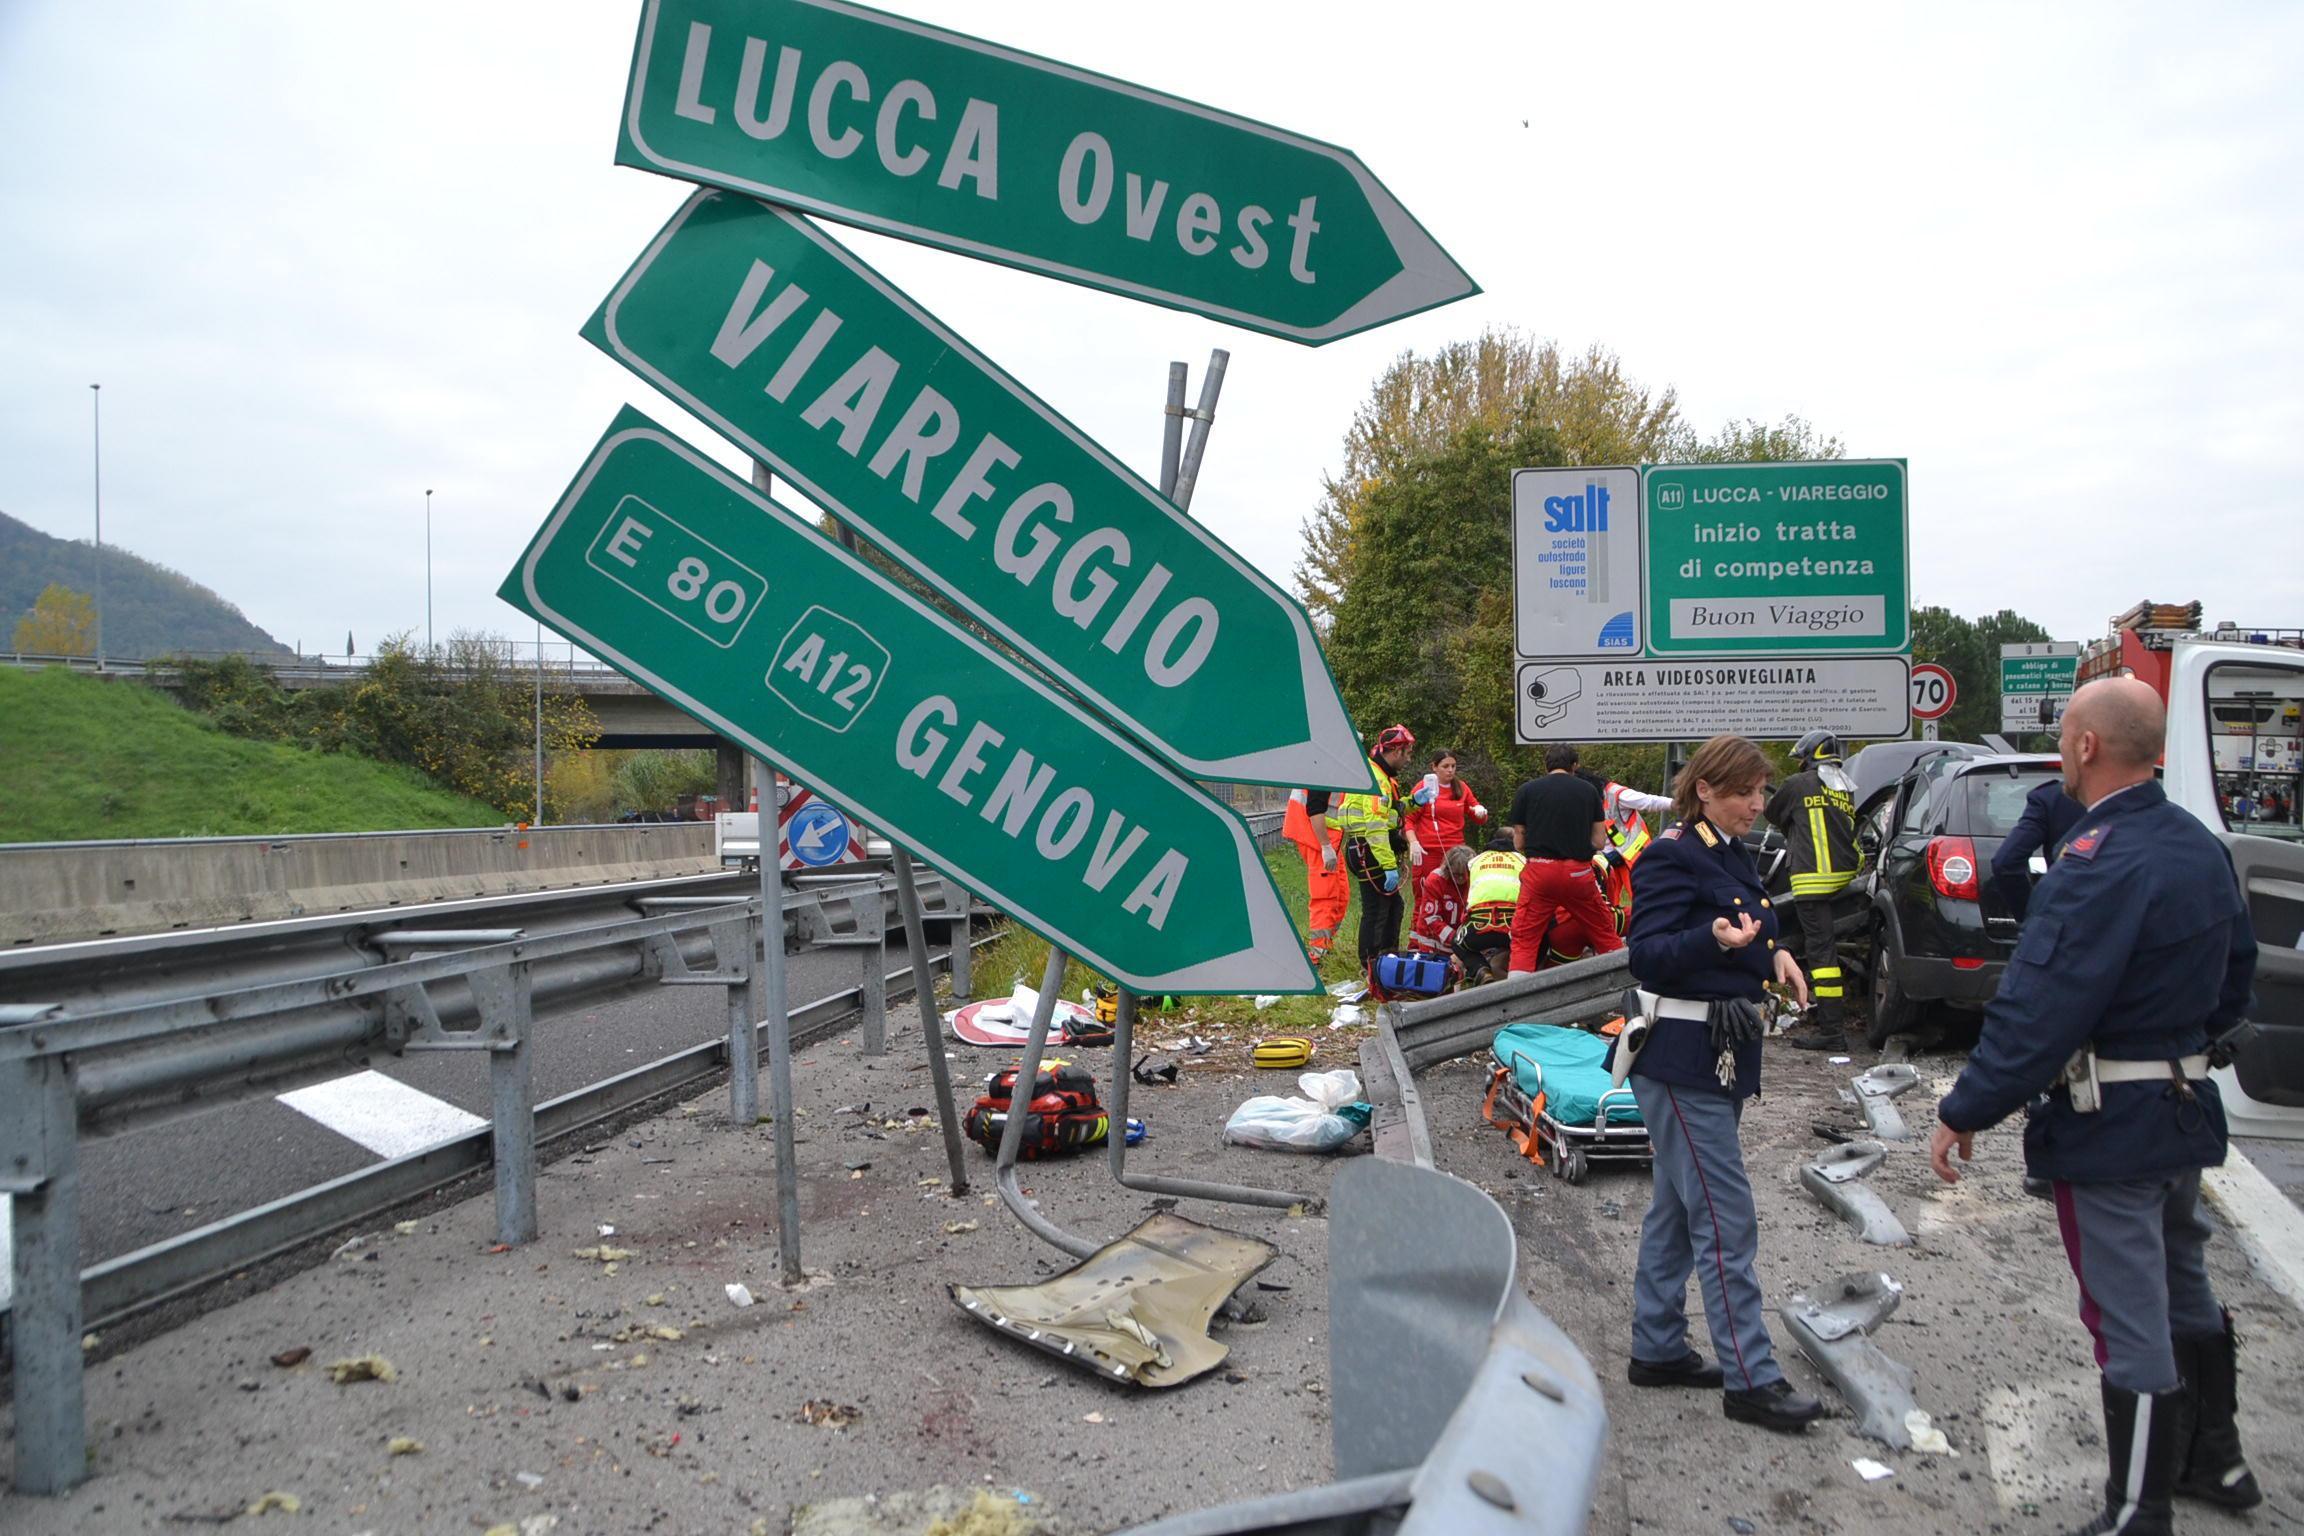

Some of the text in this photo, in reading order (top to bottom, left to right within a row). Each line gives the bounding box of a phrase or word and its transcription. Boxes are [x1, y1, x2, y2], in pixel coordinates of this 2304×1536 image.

[676, 22, 1320, 285] LUCCA Ovest
[711, 260, 1219, 687] VIAREGGIO
[1662, 490, 1681, 503] A11
[1693, 487, 1760, 503] LUCCA
[1779, 484, 1888, 501] VIAREGGIO
[1544, 484, 1610, 533] salt
[1694, 520, 1856, 543] inizio tratta
[1538, 551, 1586, 563] autostrada
[1680, 556, 1874, 580] di competenza
[606, 517, 746, 623] E 80
[1559, 565, 1586, 576] ligure
[1550, 577, 1586, 589] toscana
[1691, 604, 1864, 630] Buon Viaggio
[1604, 637, 1628, 647] SIAS
[783, 633, 872, 711] A12
[1604, 668, 1816, 686] AREA VIDEOSORVEGLIATA
[1913, 679, 1944, 704] 70
[897, 696, 1188, 931] GENOVA
[1804, 795, 1829, 808] DEL
